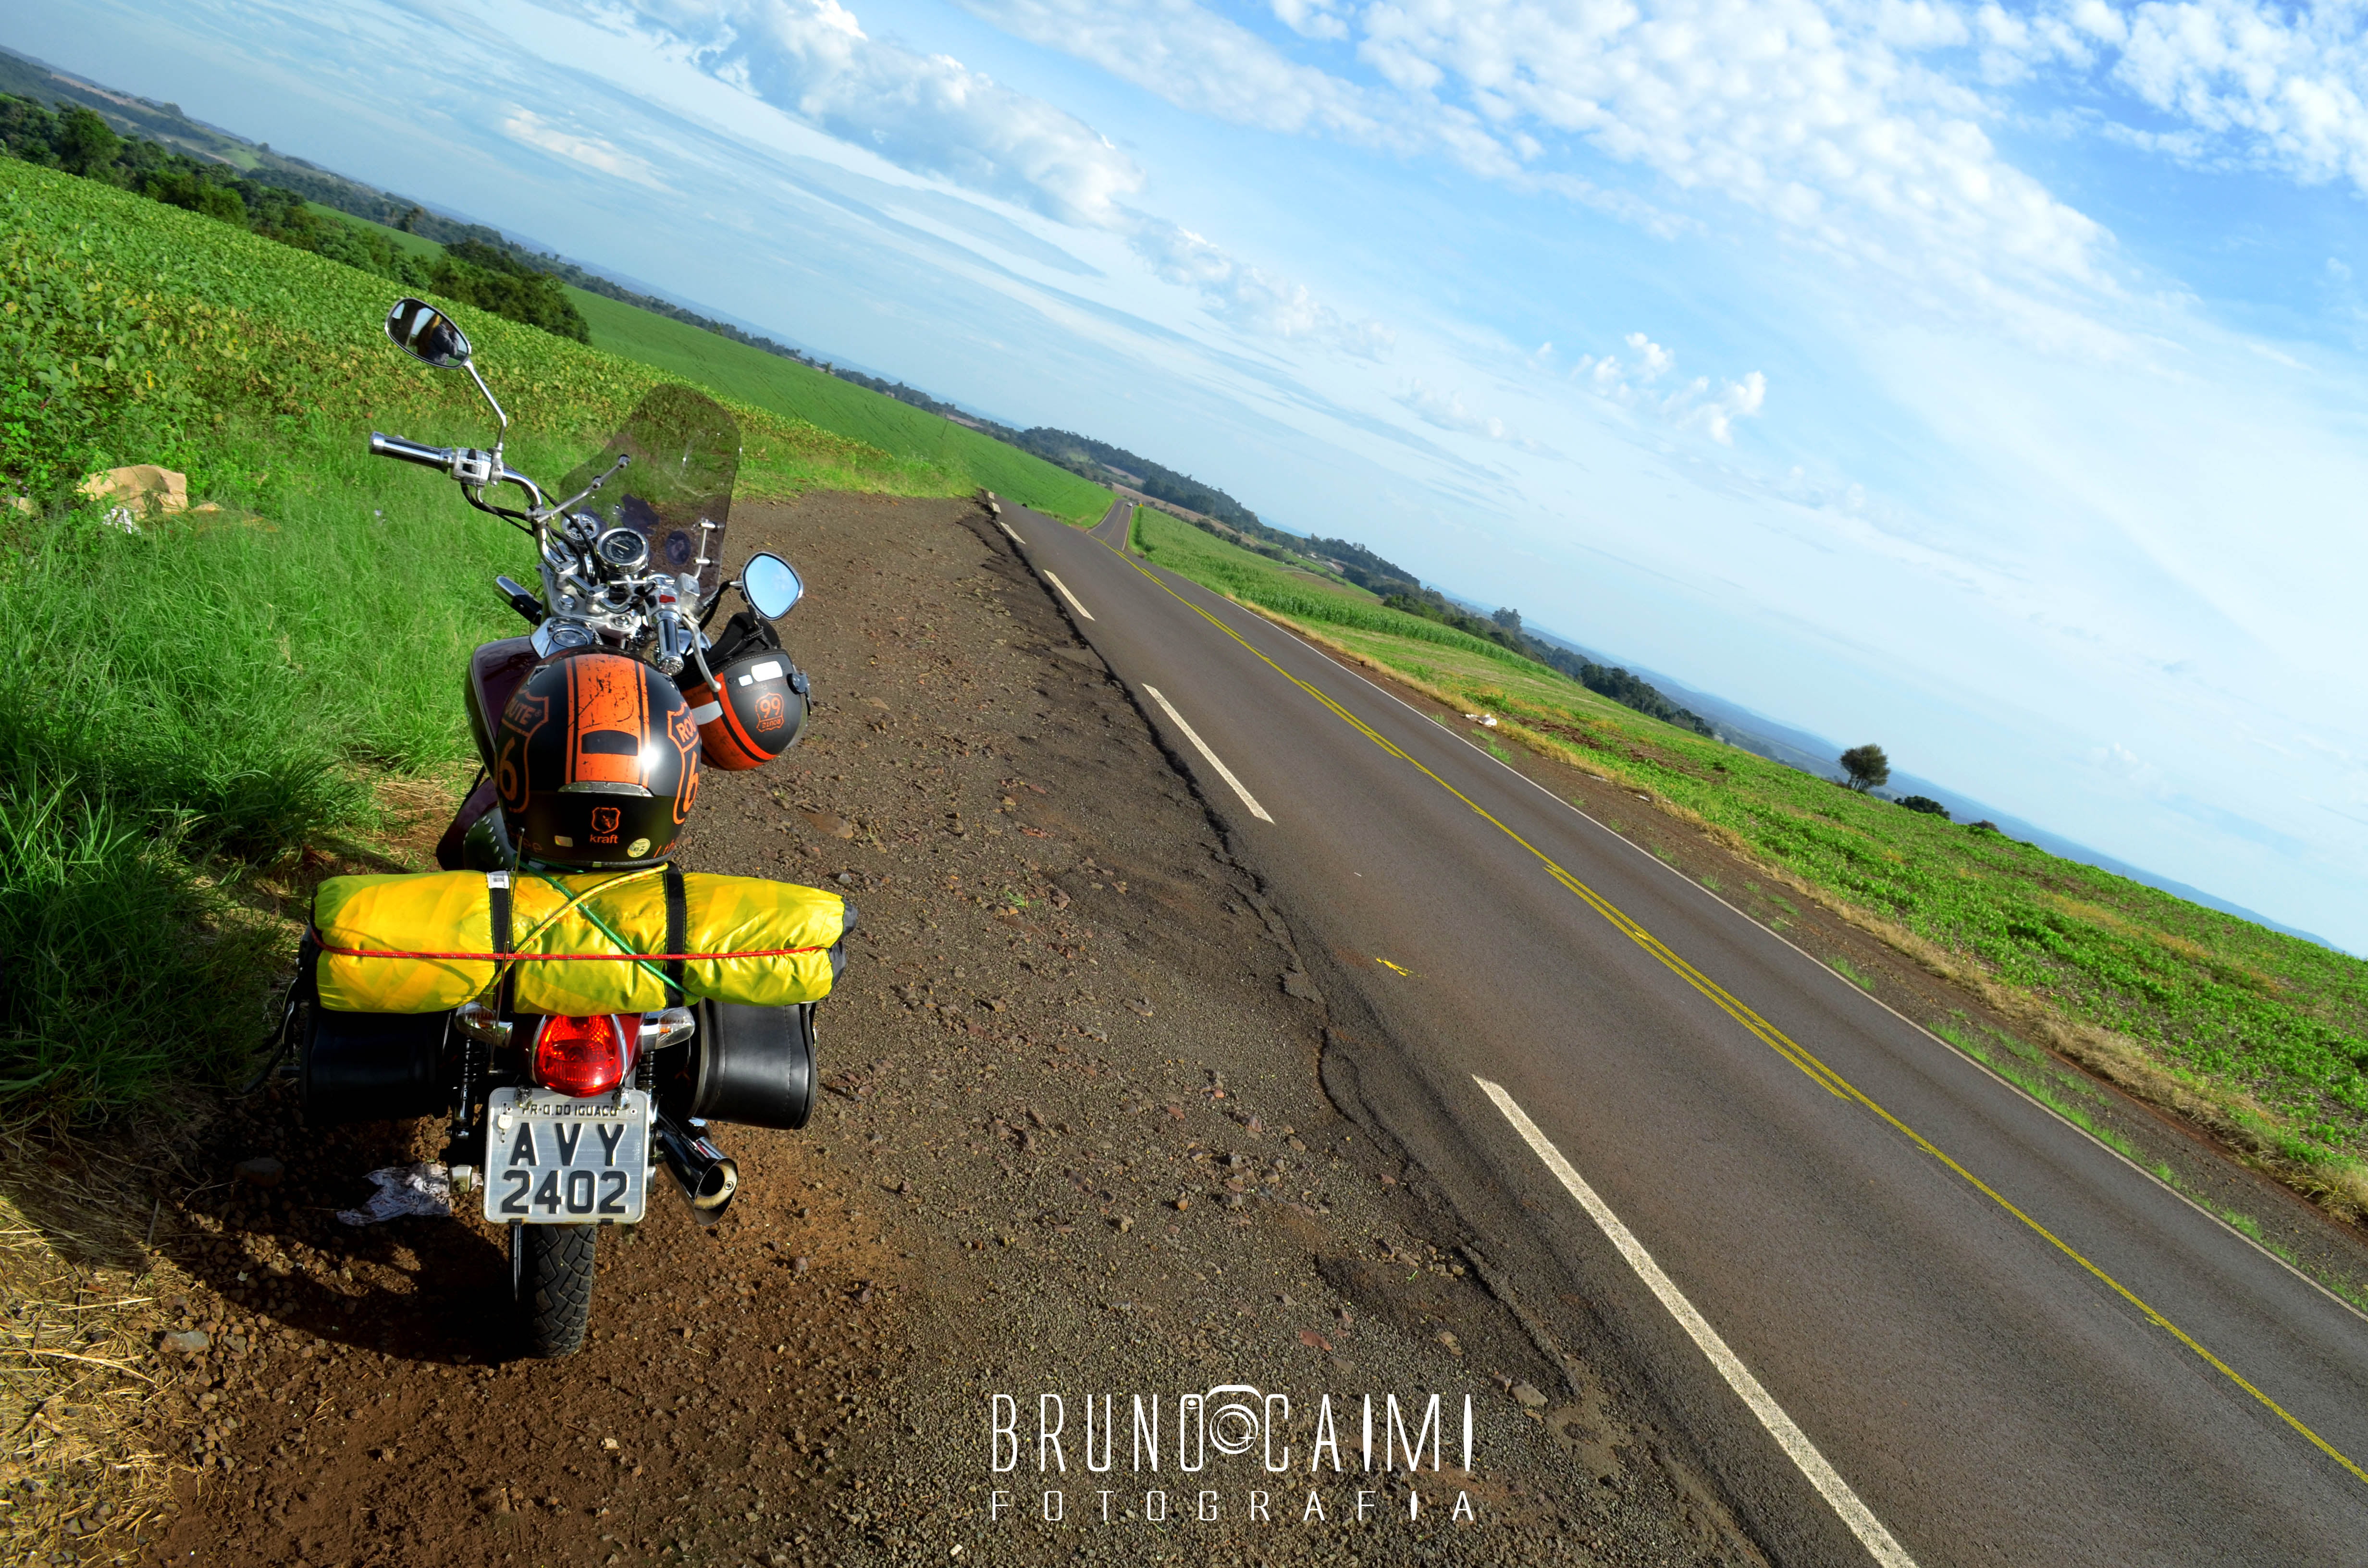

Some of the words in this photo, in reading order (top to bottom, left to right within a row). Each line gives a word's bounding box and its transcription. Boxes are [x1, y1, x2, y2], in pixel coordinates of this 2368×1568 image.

[675, 711, 697, 743] ROU
[760, 697, 781, 719] 66
[762, 718, 781, 728] ROUTE
[499, 736, 518, 801] 6
[683, 751, 699, 812] 6
[590, 834, 618, 844] kraft
[509, 1122, 625, 1166] AVY
[502, 1169, 628, 1214] 2402
